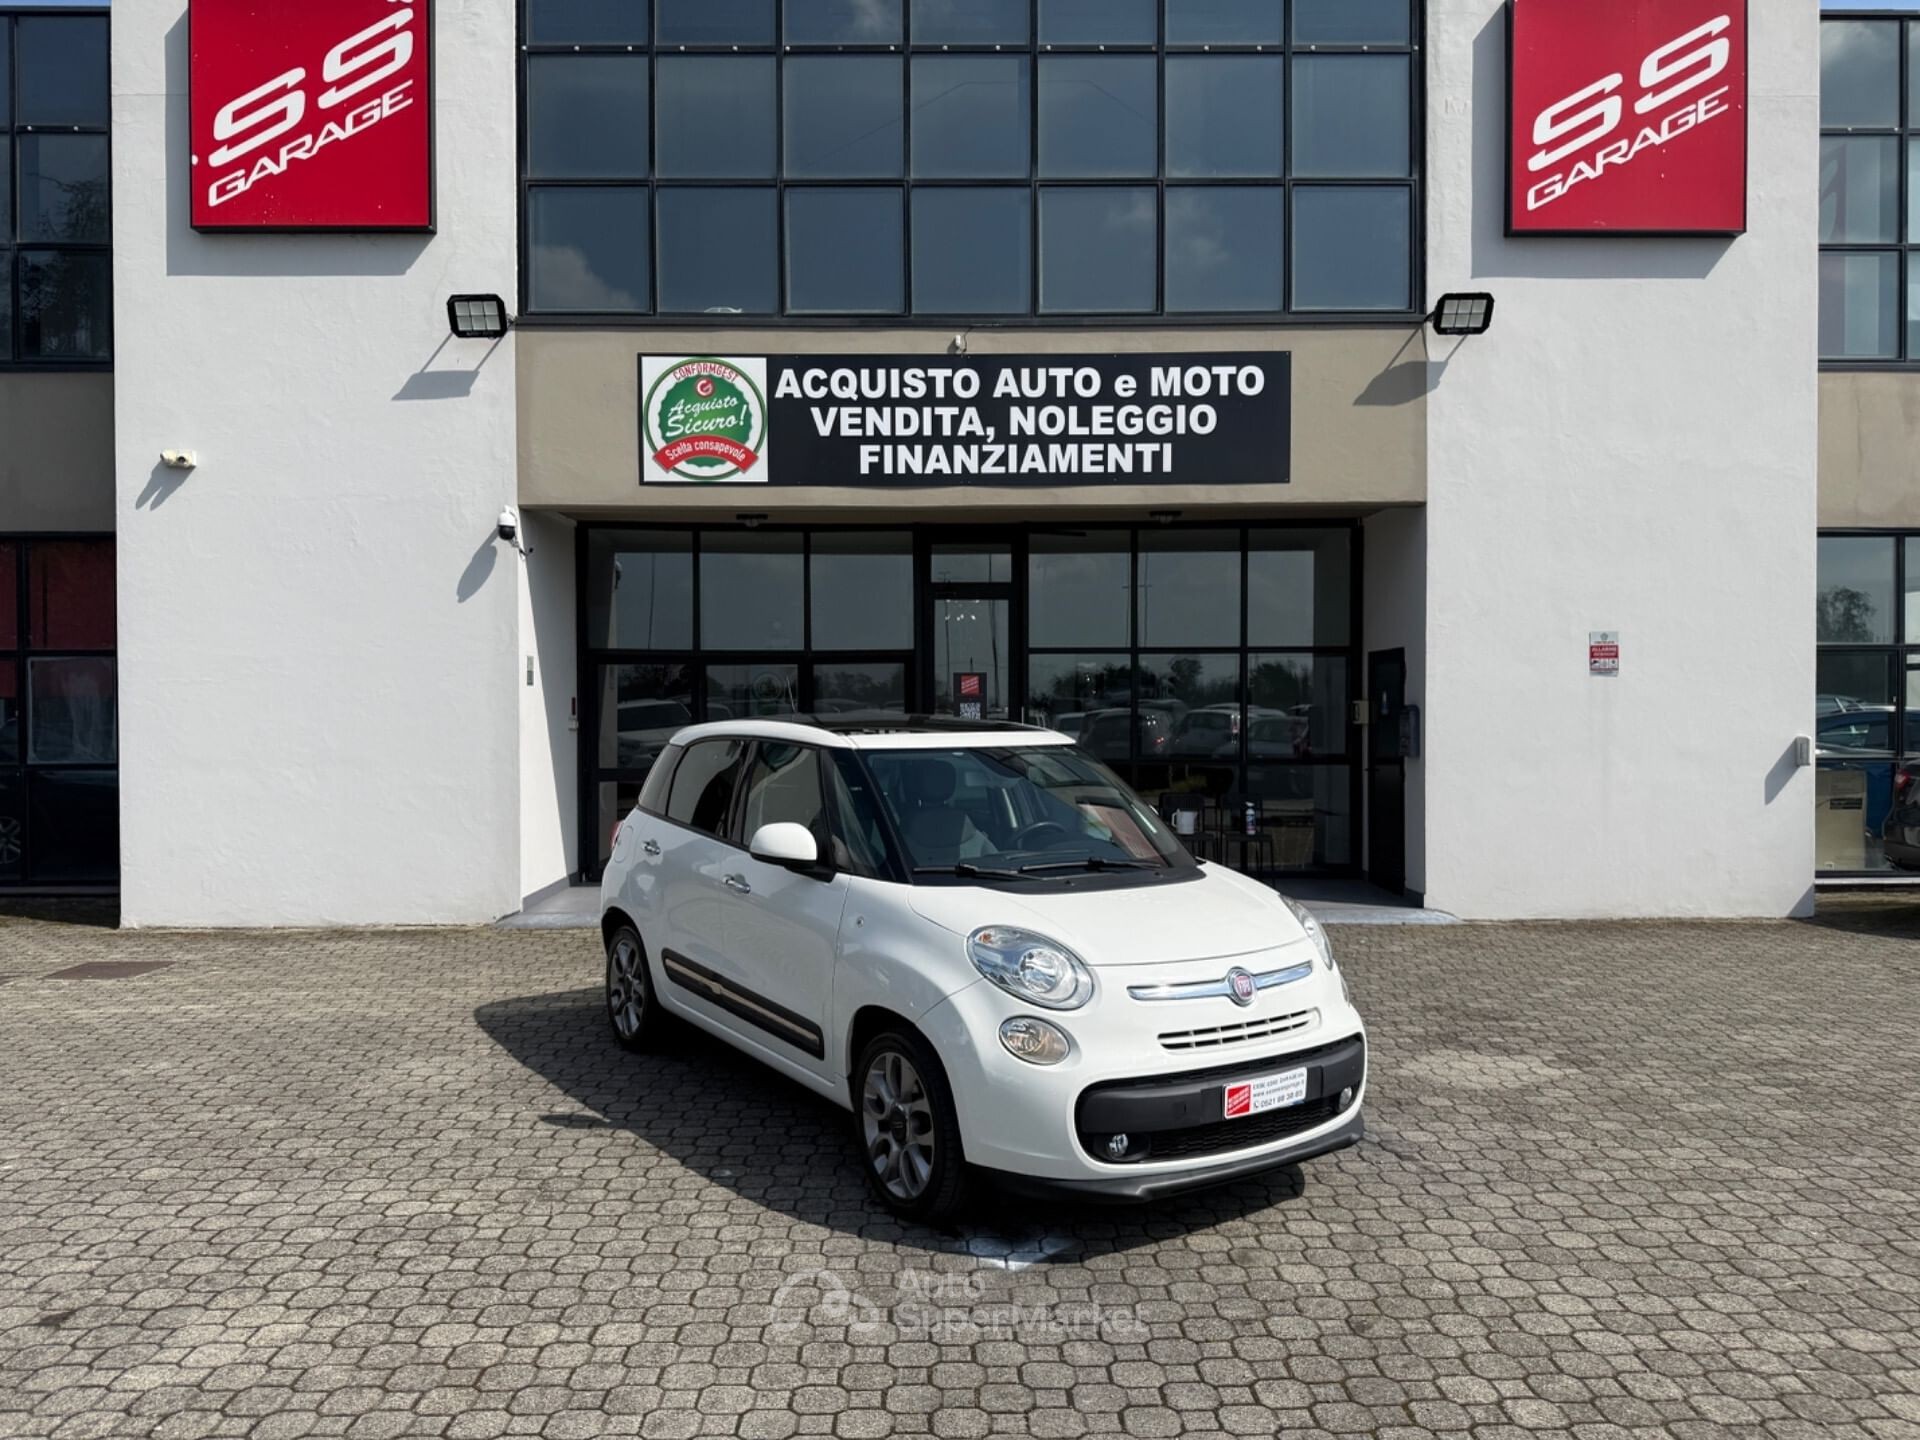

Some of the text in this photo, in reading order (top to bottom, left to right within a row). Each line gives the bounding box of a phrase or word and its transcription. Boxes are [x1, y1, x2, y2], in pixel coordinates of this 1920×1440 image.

[208, 79, 414, 207] GARAGE
[1527, 85, 1729, 211] GARAGE
[673, 362, 738, 382] CONFORMGEST
[775, 365, 1265, 400] ACQUISTO AUTO e MOTO
[665, 404, 748, 437] Sicuro!
[668, 396, 738, 417] Acquisto
[811, 404, 1217, 442] VENDITA, NOLEGGIO
[665, 441, 746, 462] Scelta consapevole
[859, 443, 1172, 474] FINANZIAMENTI
